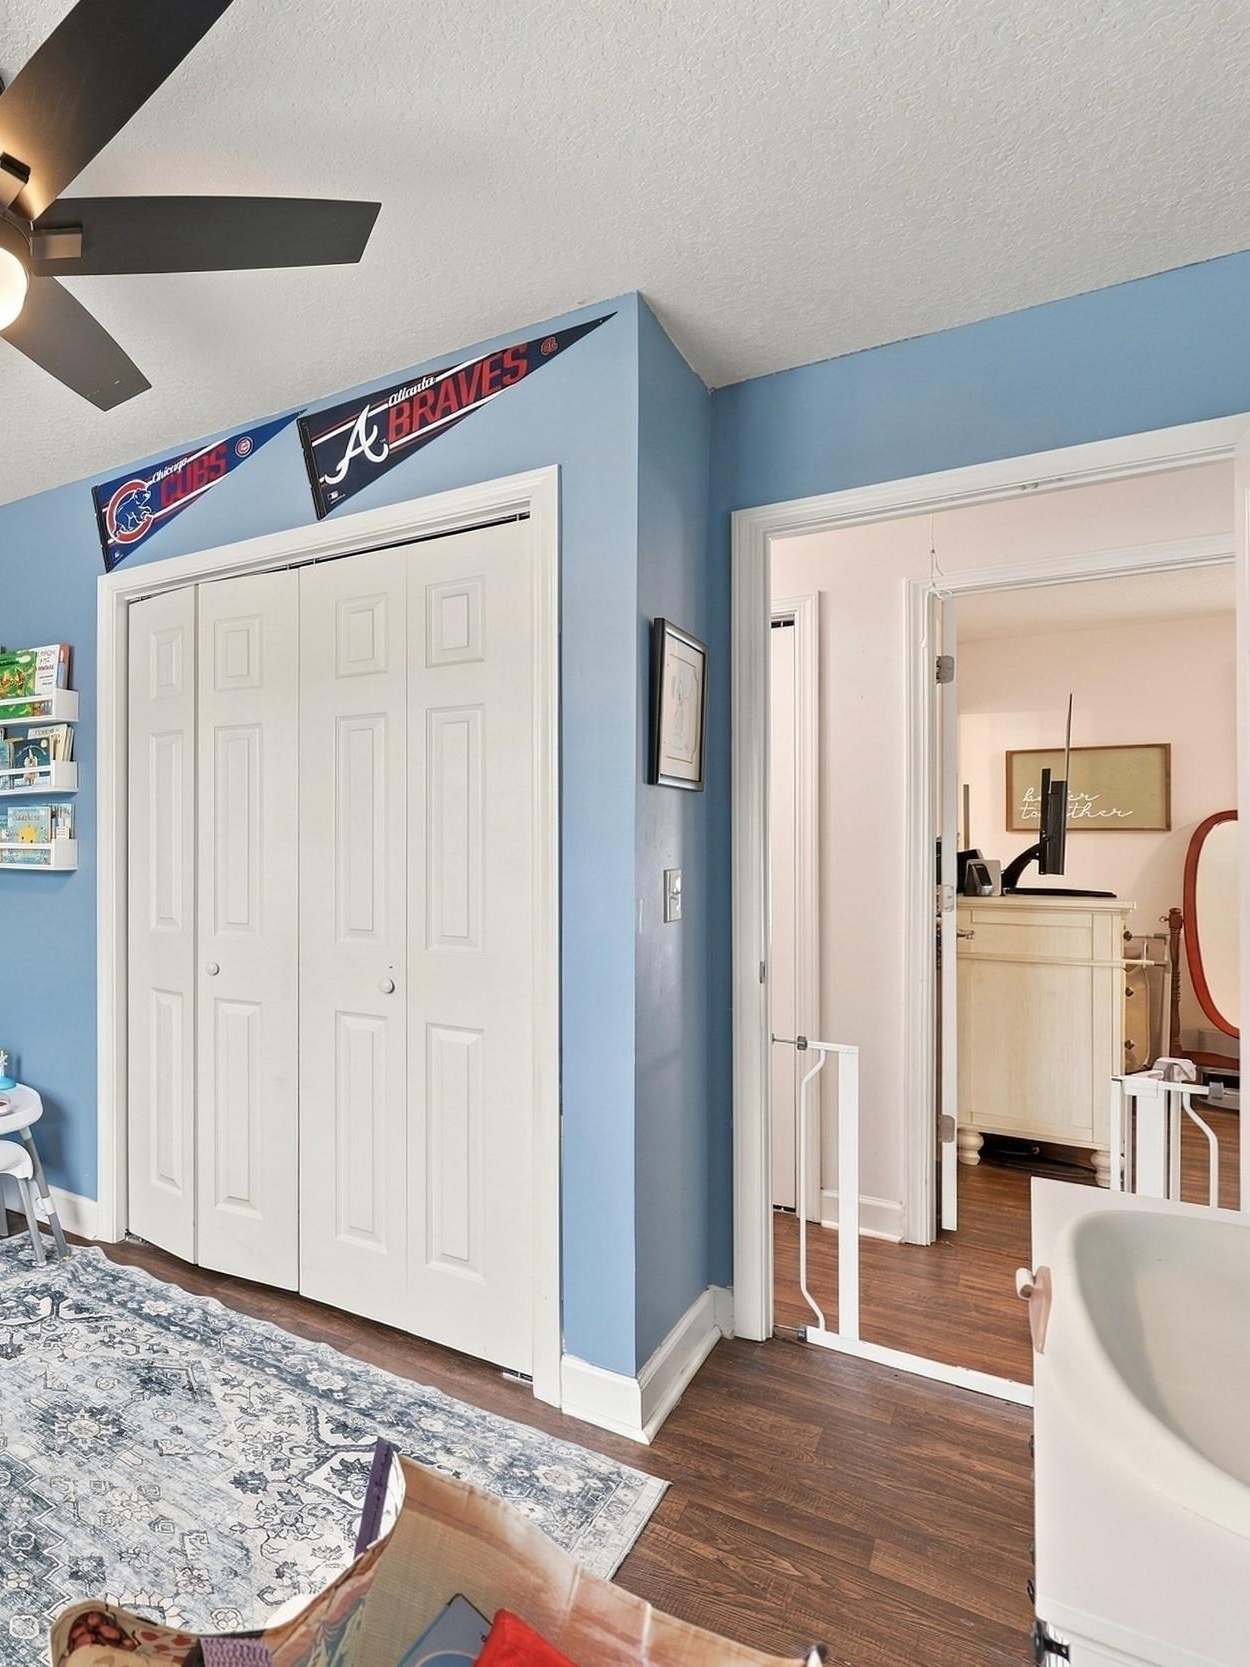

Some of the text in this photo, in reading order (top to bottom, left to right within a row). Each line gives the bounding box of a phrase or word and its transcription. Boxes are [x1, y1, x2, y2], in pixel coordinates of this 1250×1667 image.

[388, 375, 437, 407] Atlanta
[388, 342, 528, 442] BRAVES
[324, 404, 388, 485] A
[151, 457, 188, 483] Chicago
[160, 442, 228, 507] CUBS
[1020, 802, 1134, 819] tother
